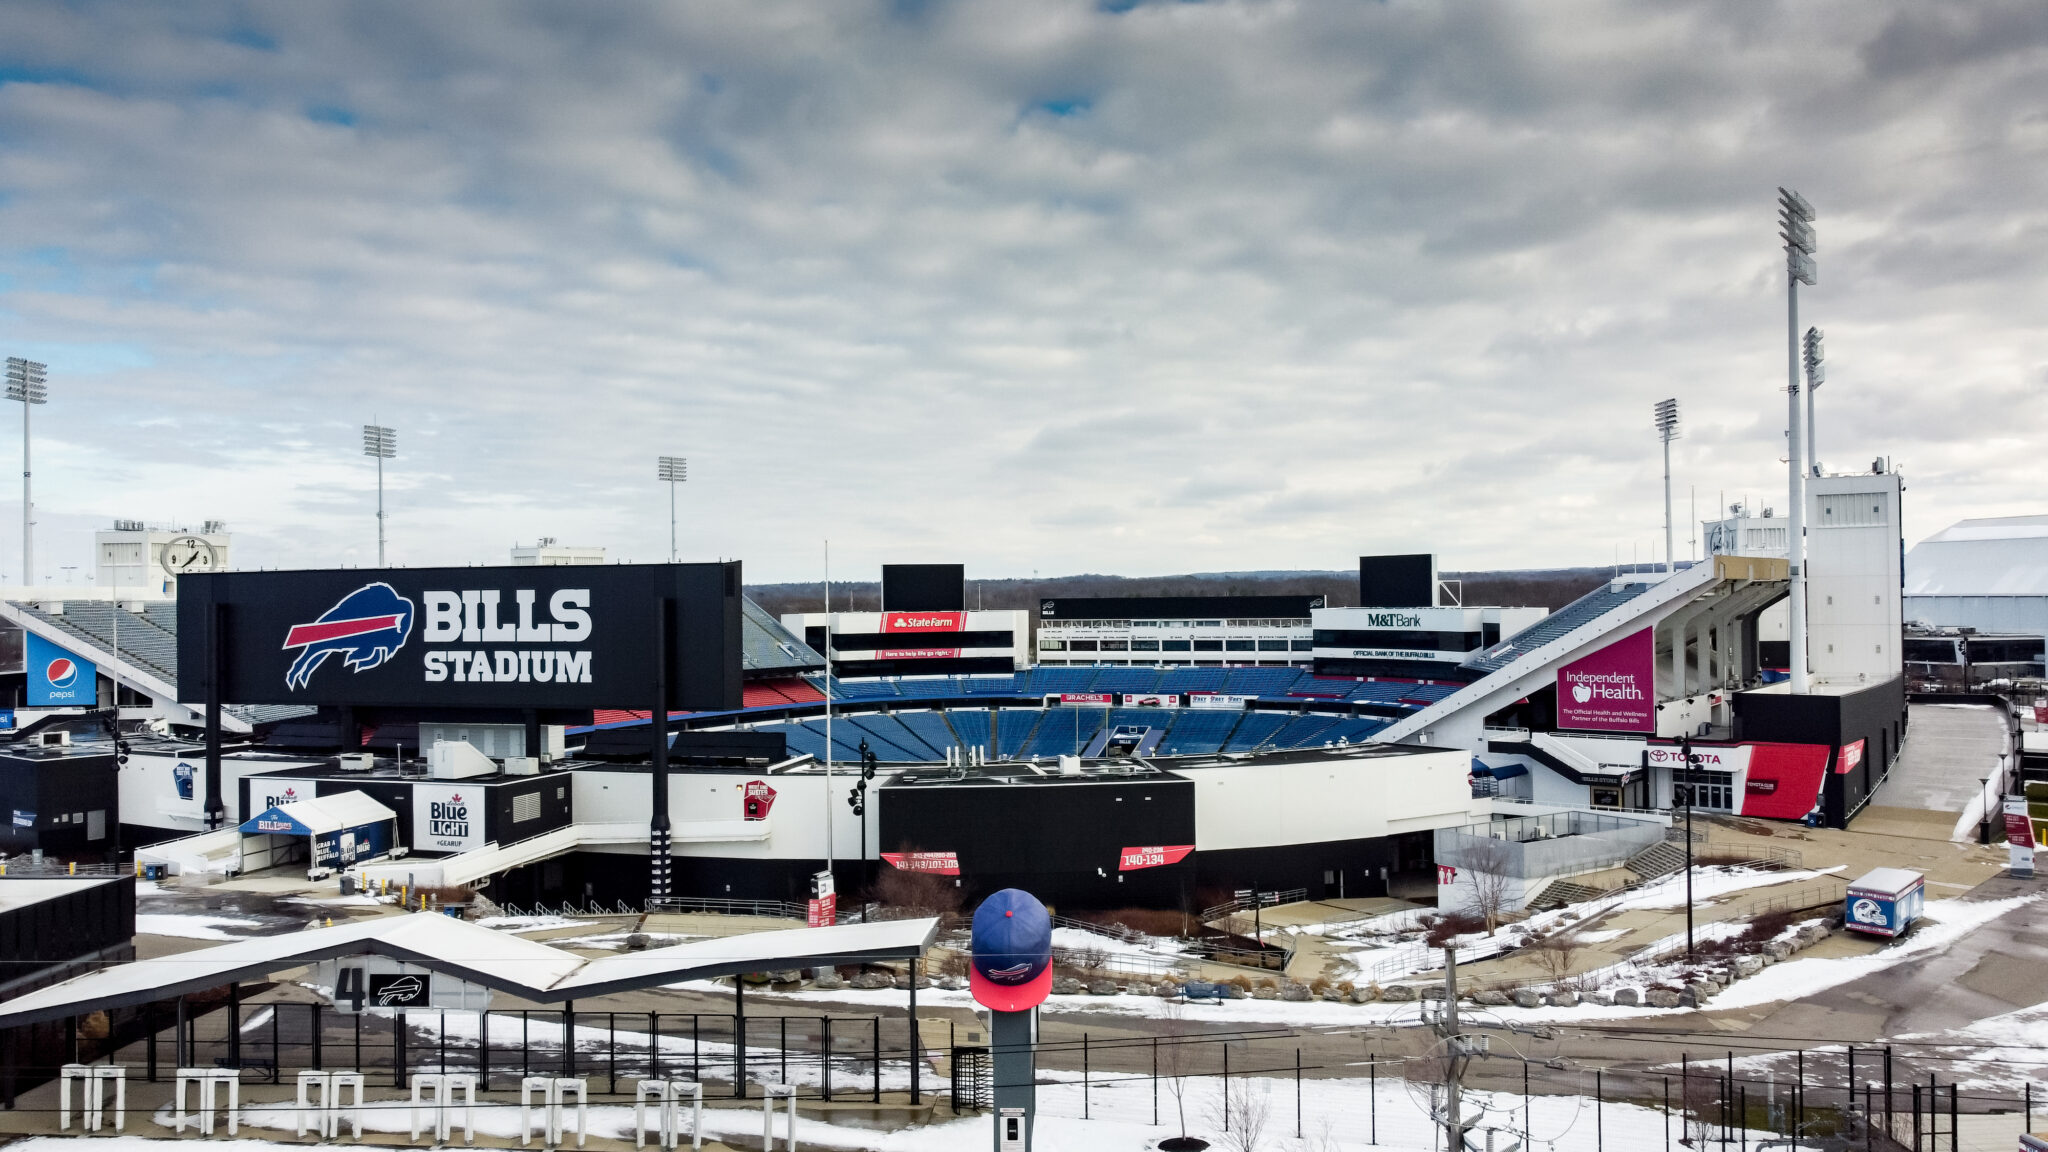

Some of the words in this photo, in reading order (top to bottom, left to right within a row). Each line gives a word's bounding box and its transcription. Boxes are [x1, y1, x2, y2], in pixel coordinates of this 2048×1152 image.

[186, 540, 196, 548] 12
[203, 555, 208, 565] 3
[423, 589, 592, 642] BILLS
[424, 650, 593, 683] STADIUM
[1566, 671, 1635, 686] Independent
[49, 690, 75, 699] pepsi
[1669, 752, 1721, 765] TOOTA
[431, 802, 467, 820] Blue
[431, 821, 468, 837] LIGHT
[1124, 854, 1164, 866] 140-134
[335, 968, 366, 1011] 4
